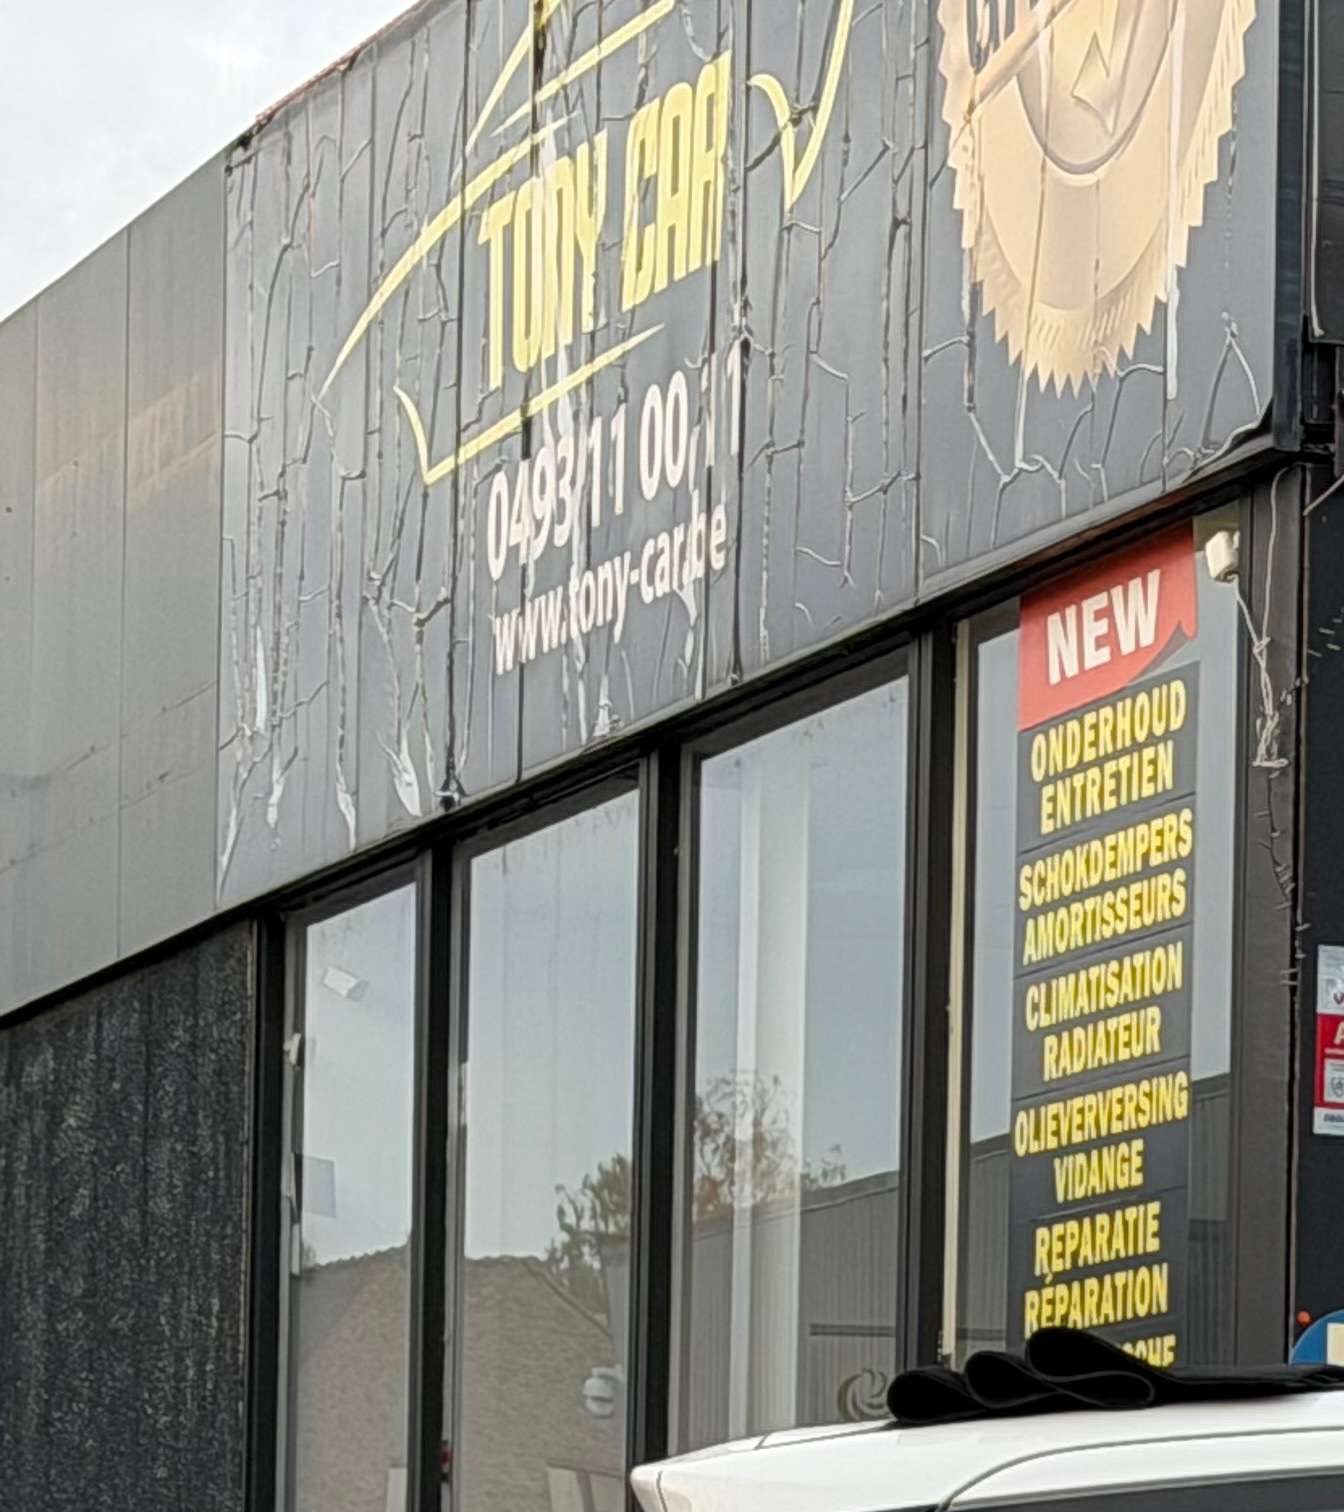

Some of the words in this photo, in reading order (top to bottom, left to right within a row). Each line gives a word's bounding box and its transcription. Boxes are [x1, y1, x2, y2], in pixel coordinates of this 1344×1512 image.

[478, 127, 608, 391] TONY
[622, 48, 732, 312] CAR
[640, 371, 688, 500] 00
[1047, 568, 1161, 686] NEW
[1031, 679, 1187, 783] ONDERHOUD
[1040, 739, 1175, 836] ENTRETIEN
[1019, 808, 1193, 911] SCHOKDEMPERS
[1023, 868, 1187, 966] AMORTISSEURS
[1026, 941, 1183, 1032] CLIMATISATION
[1044, 1005, 1161, 1082] RADIATEUR
[1015, 1070, 1189, 1158] OLIEVERVERSING
[1054, 1138, 1144, 1203] VIDANGE
[1034, 1201, 1161, 1277] REPARATIE
[1024, 1262, 1169, 1340] RÉPARATION
